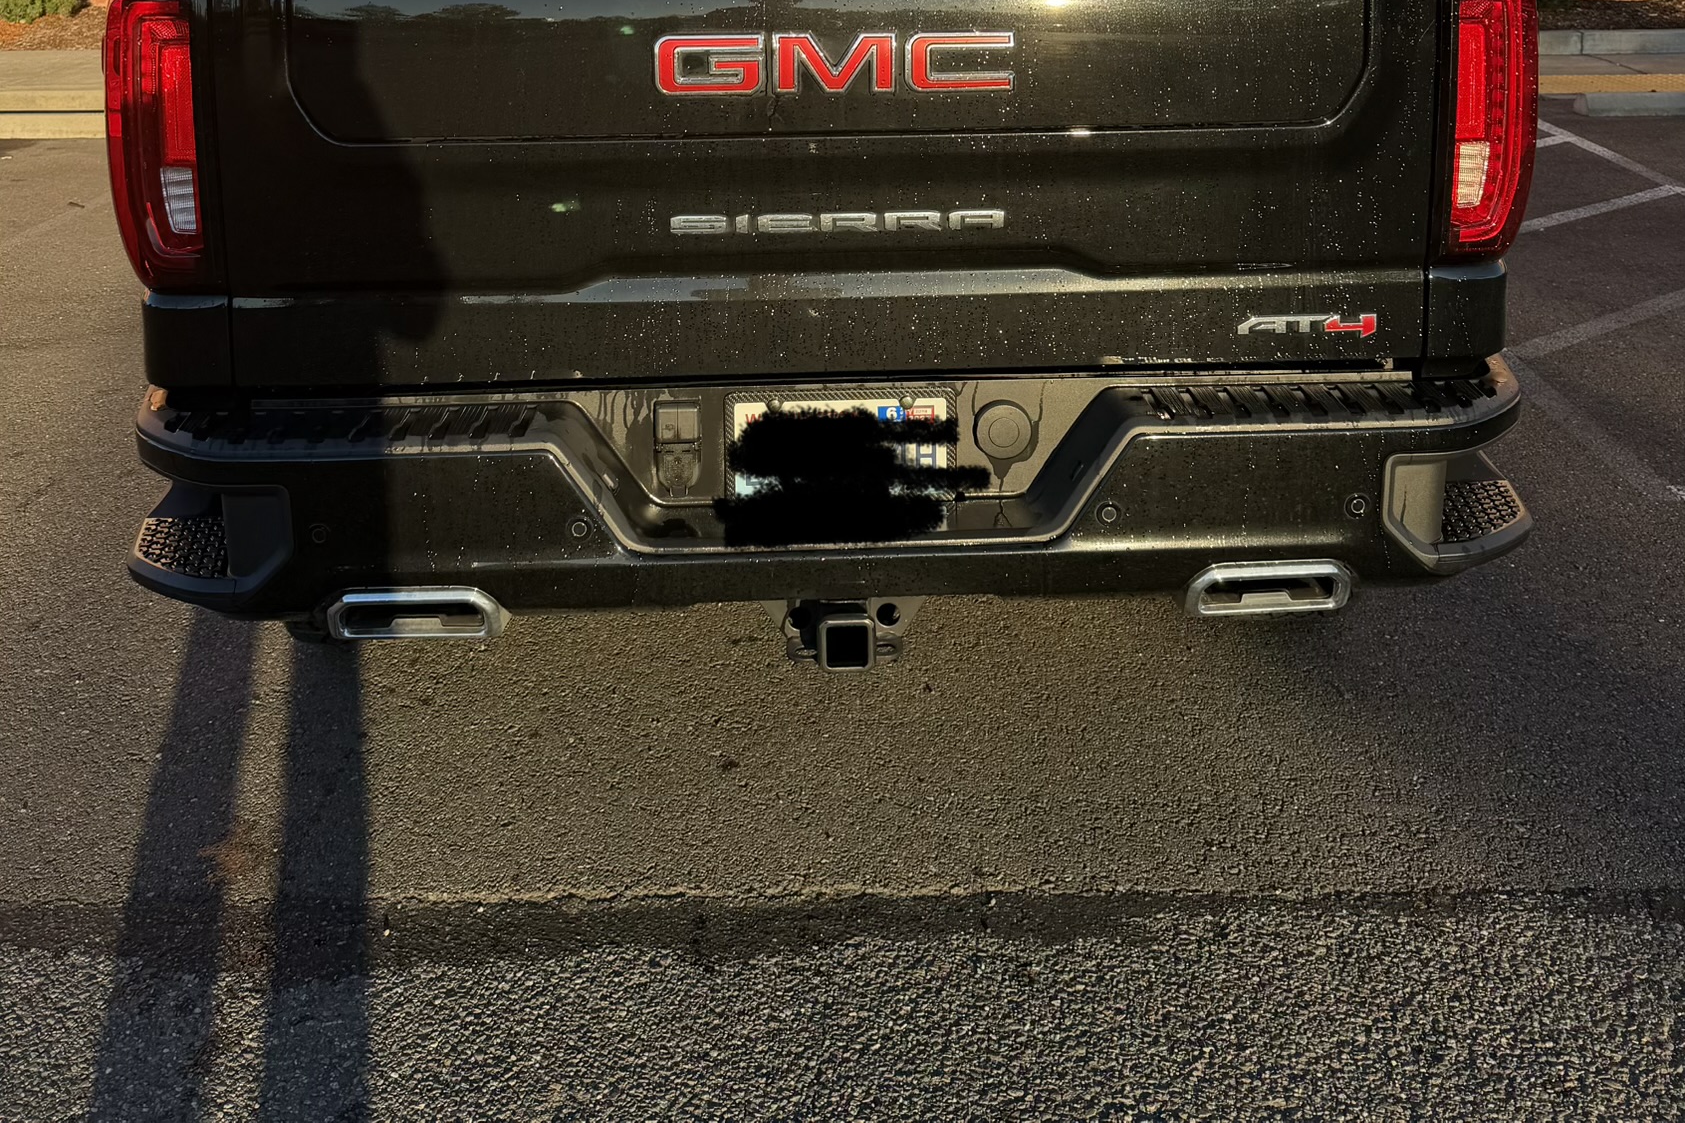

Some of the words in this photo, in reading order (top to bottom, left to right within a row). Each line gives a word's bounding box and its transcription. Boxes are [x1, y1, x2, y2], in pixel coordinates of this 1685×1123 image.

[654, 31, 1015, 95] GMC
[670, 210, 1005, 234] SIERRA
[1237, 314, 1377, 338] AT4
